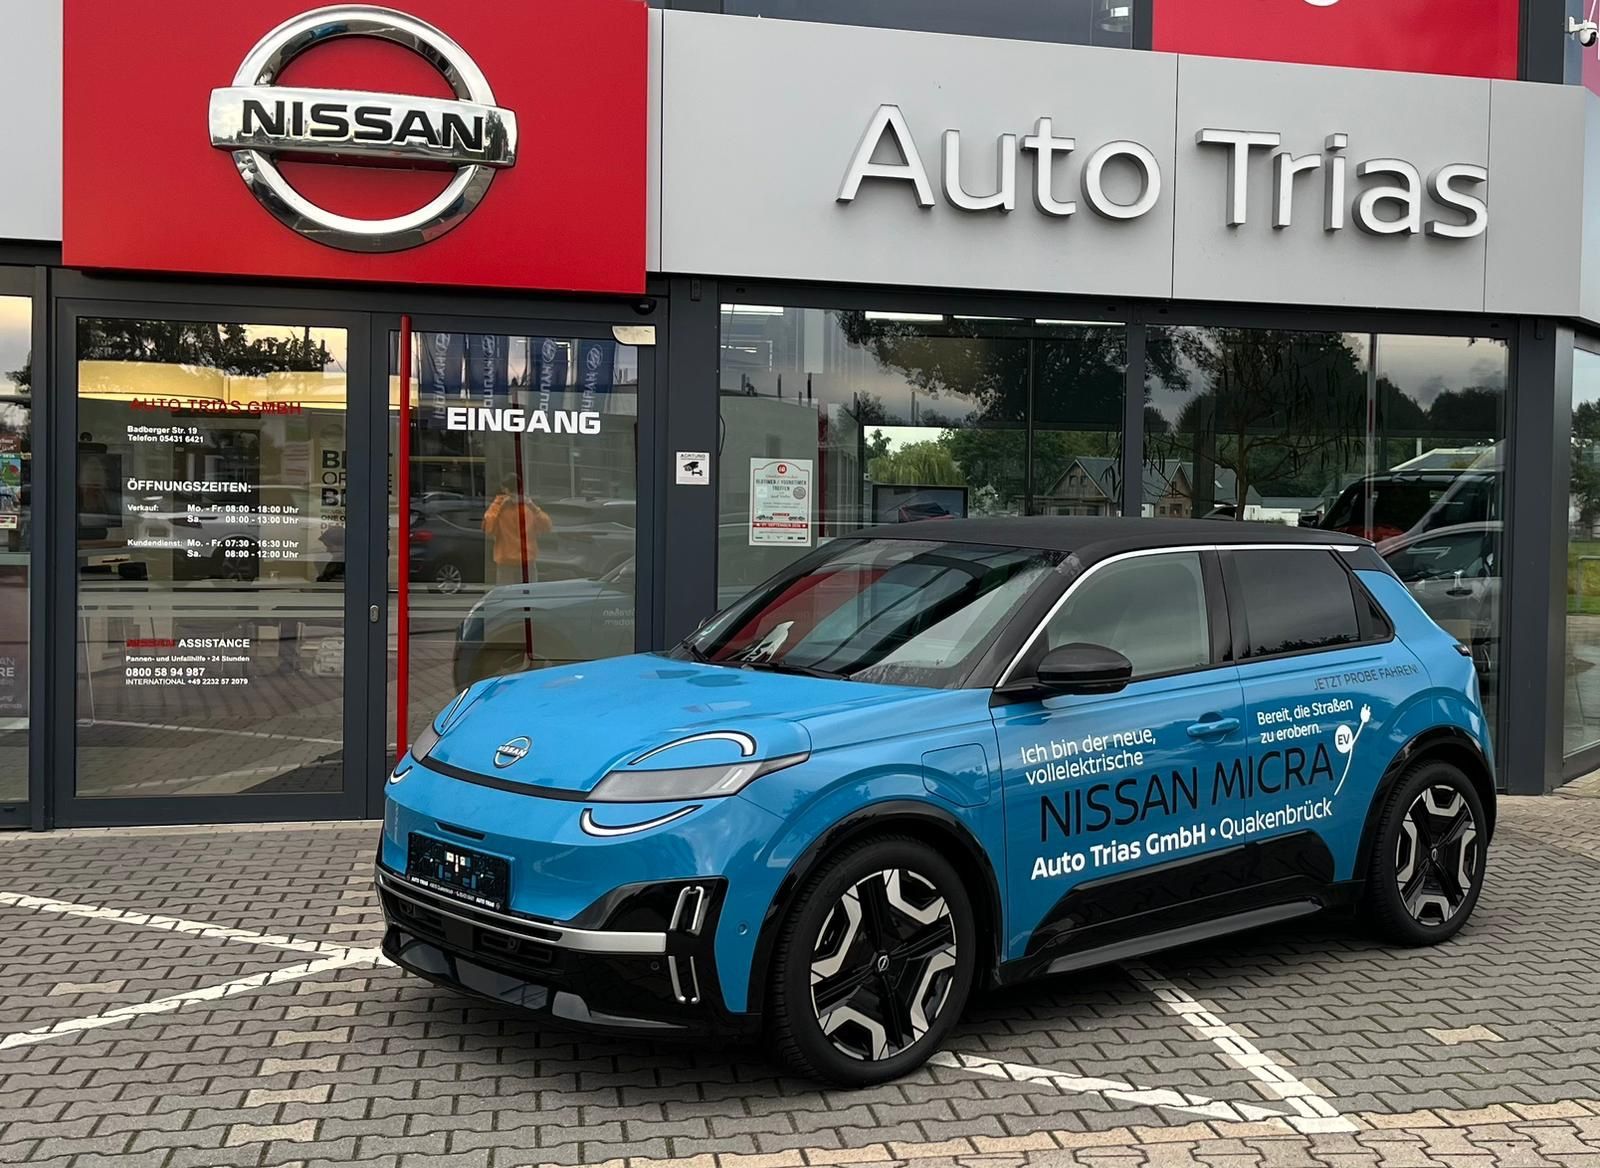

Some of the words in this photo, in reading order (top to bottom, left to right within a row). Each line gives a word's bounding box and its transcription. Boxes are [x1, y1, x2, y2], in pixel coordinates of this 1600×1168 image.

[242, 99, 484, 152] NISSAN
[836, 104, 1161, 220] Auto
[1196, 128, 1489, 239] Trias
[129, 398, 181, 412] AUTO
[188, 399, 241, 415] TRIAS
[248, 401, 302, 415] GMBH
[447, 407, 601, 435] EINGANG
[127, 426, 170, 436] Badberger
[171, 427, 185, 435] Str.
[188, 427, 198, 435] 19
[127, 434, 158, 442] Telefon
[159, 435, 183, 443] 05431
[185, 435, 204, 443] 6421
[127, 478, 252, 493] ÖFFNUNGSZEITEN:
[127, 504, 159, 512] Verkauf:
[187, 504, 203, 512] Mo.
[211, 504, 223, 512] Fr.
[225, 504, 250, 512] 08:00
[257, 504, 281, 513] 18:00
[282, 505, 299, 513] Uhr
[187, 515, 201, 523] Sa.
[225, 515, 250, 523] 08:00
[257, 515, 281, 524] 13:00
[282, 516, 299, 524] Uhr
[187, 539, 203, 547] Mo.
[211, 539, 223, 547] Fr.
[225, 539, 250, 547] 07:30
[257, 539, 281, 548] 16:30
[282, 540, 299, 548] Uhr
[187, 550, 201, 558] Sa.
[225, 550, 250, 558] 08:00
[257, 550, 281, 559] 12:00
[282, 551, 299, 559] Uhr
[178, 639, 250, 648] ASSISTANCE
[126, 667, 152, 677] 0800
[154, 667, 168, 677] 58
[170, 668, 183, 677] 94
[186, 668, 206, 677] 987
[1313, 675, 1342, 691] JETZT
[1344, 671, 1379, 685] PROBE
[1380, 664, 1419, 680] FAHREN!
[126, 678, 186, 686] INTERNATIONAL
[1257, 706, 1293, 726] Bereit,
[1294, 705, 1310, 719] die
[1312, 698, 1353, 716] Straßen
[1260, 731, 1274, 744] zu
[1276, 723, 1322, 741] erobern.
[1338, 734, 1350, 745] EV
[1021, 743, 1047, 764] Ich
[1051, 739, 1078, 759] bin
[1082, 734, 1109, 753] der
[1113, 728, 1156, 748] neue,
[1025, 750, 1143, 785] vollelektrische
[1040, 766, 1198, 842] NISSAN
[1211, 742, 1334, 805] MICRA
[1031, 850, 1085, 881] Auto
[1090, 839, 1141, 867] Trias
[1146, 823, 1206, 856] GmbH
[1220, 797, 1333, 839] Quakenbrück
